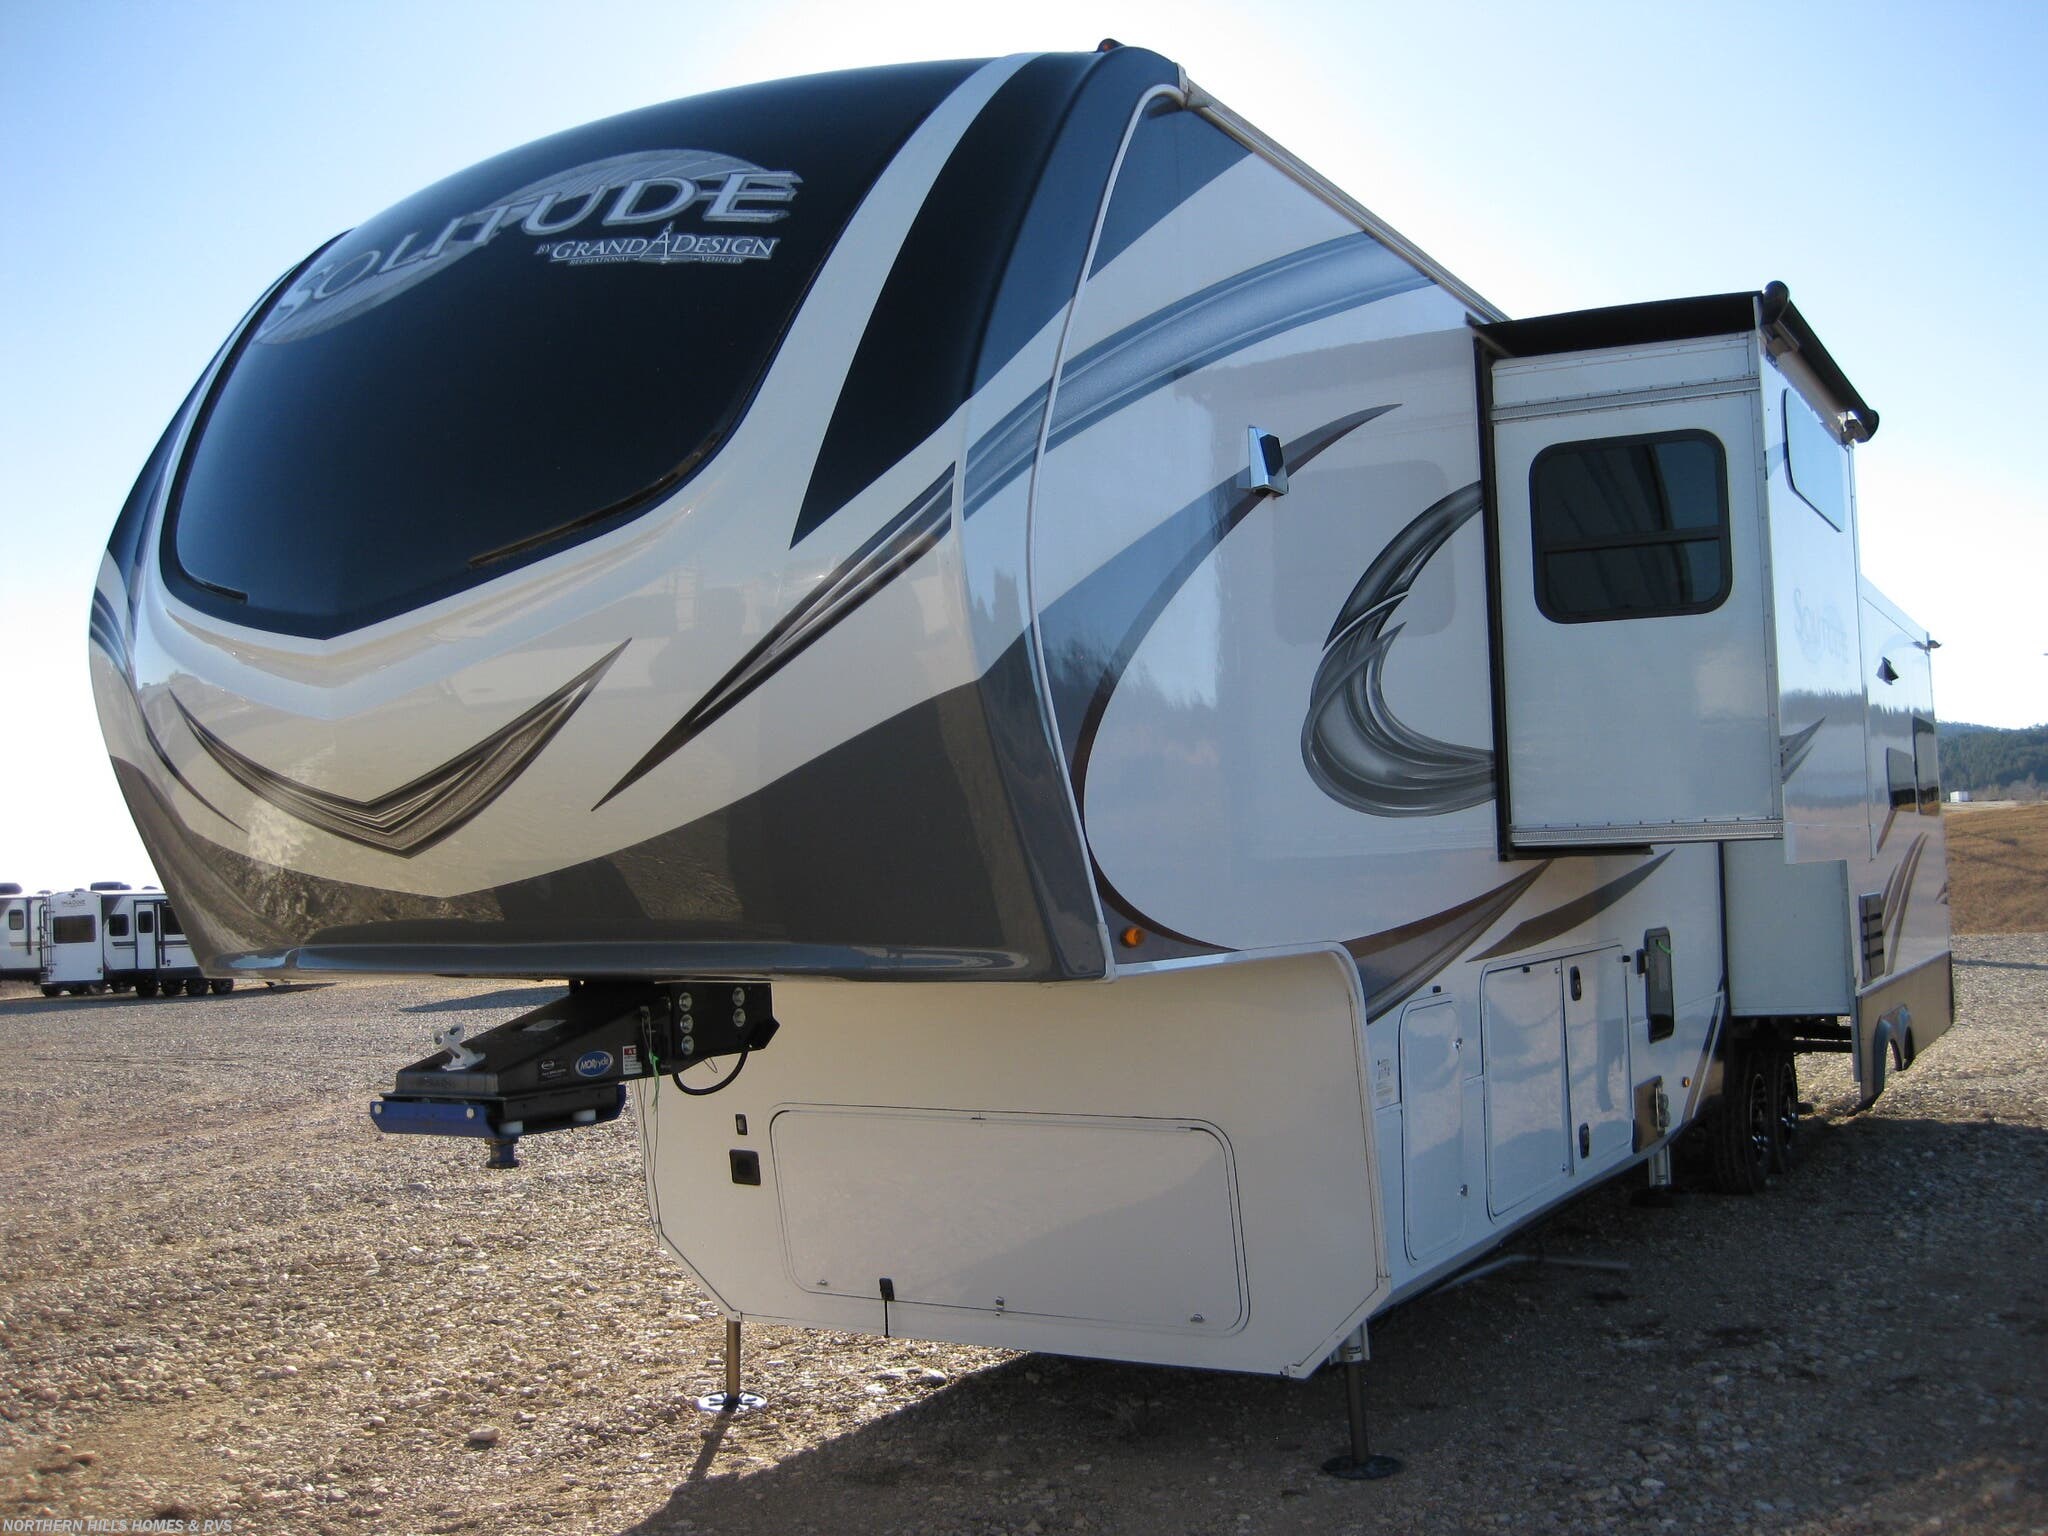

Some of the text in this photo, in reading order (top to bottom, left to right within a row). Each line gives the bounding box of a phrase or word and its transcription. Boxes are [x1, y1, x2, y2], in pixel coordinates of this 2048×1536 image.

[254, 170, 803, 342] SOLITUDE
[552, 238, 648, 260] GRAND
[670, 235, 779, 256] DESIGN
